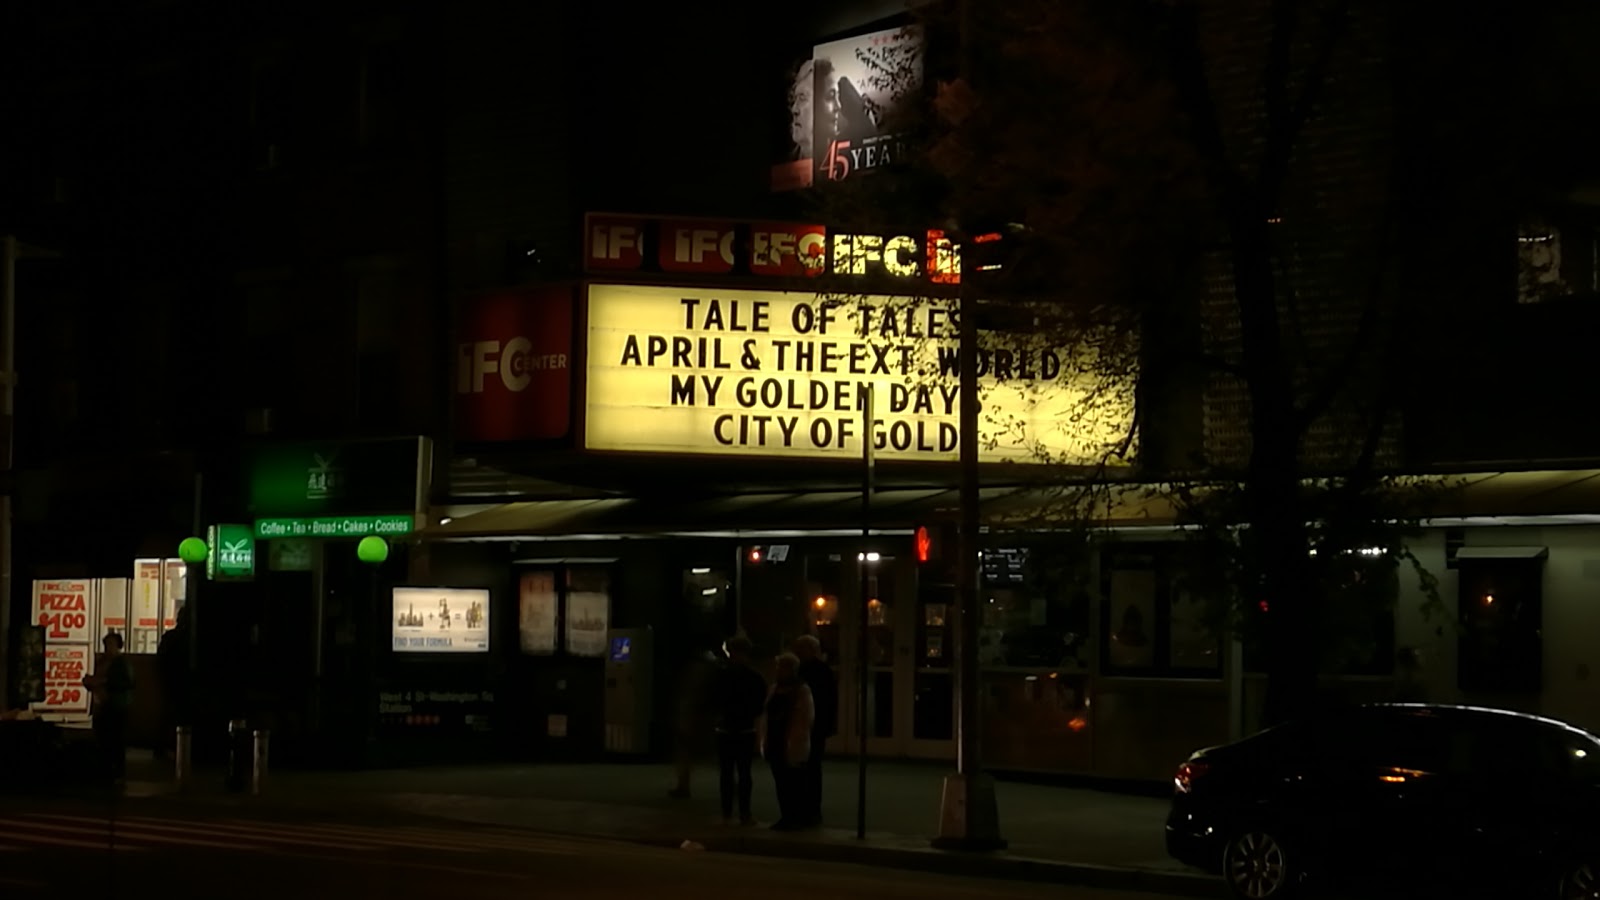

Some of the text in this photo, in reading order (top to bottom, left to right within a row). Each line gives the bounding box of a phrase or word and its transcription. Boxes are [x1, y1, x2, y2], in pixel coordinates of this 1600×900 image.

[819, 139, 851, 182] 45
[681, 299, 769, 332] TALE
[792, 303, 836, 334] OF
[514, 353, 568, 371] CENTER
[620, 335, 731, 369] APRIL
[741, 339, 761, 371] &
[772, 340, 837, 374] THE
[671, 375, 723, 406] MY
[714, 414, 959, 452] CITY OF GOLD
[261, 518, 408, 534] Coffee Tea Bread Cakes Cookies
[40, 593, 86, 611] PIZZA
[426, 637, 452, 647] FORMULA
[49, 661, 83, 671] PIZZA
